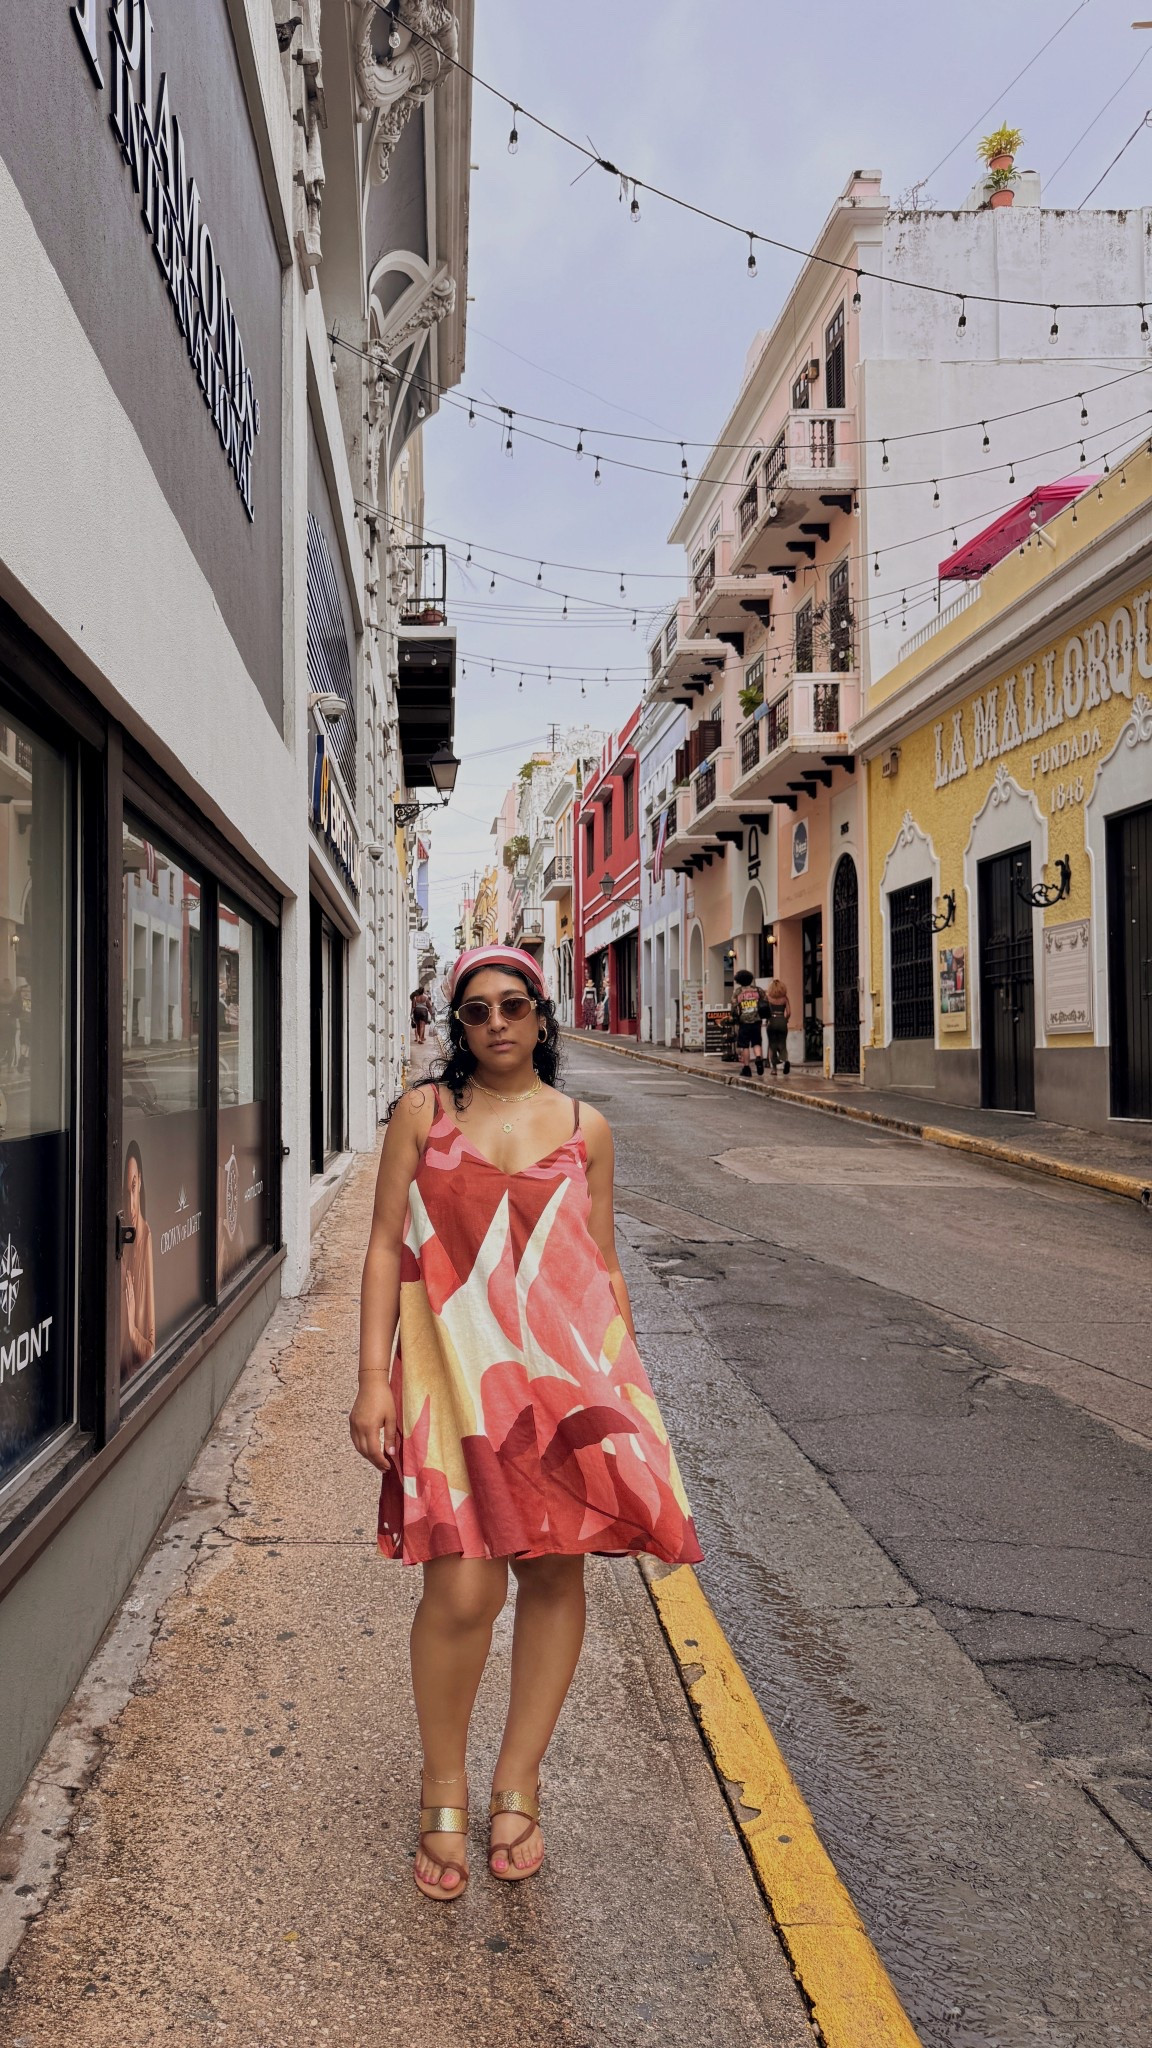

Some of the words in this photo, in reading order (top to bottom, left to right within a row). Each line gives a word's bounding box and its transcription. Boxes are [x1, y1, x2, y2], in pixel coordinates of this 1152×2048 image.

[933, 709, 968, 790] LA
[1031, 726, 1102, 779] FUNDADA
[1050, 775, 1084, 814] 1848
[160, 1224, 181, 1255] CROWN
